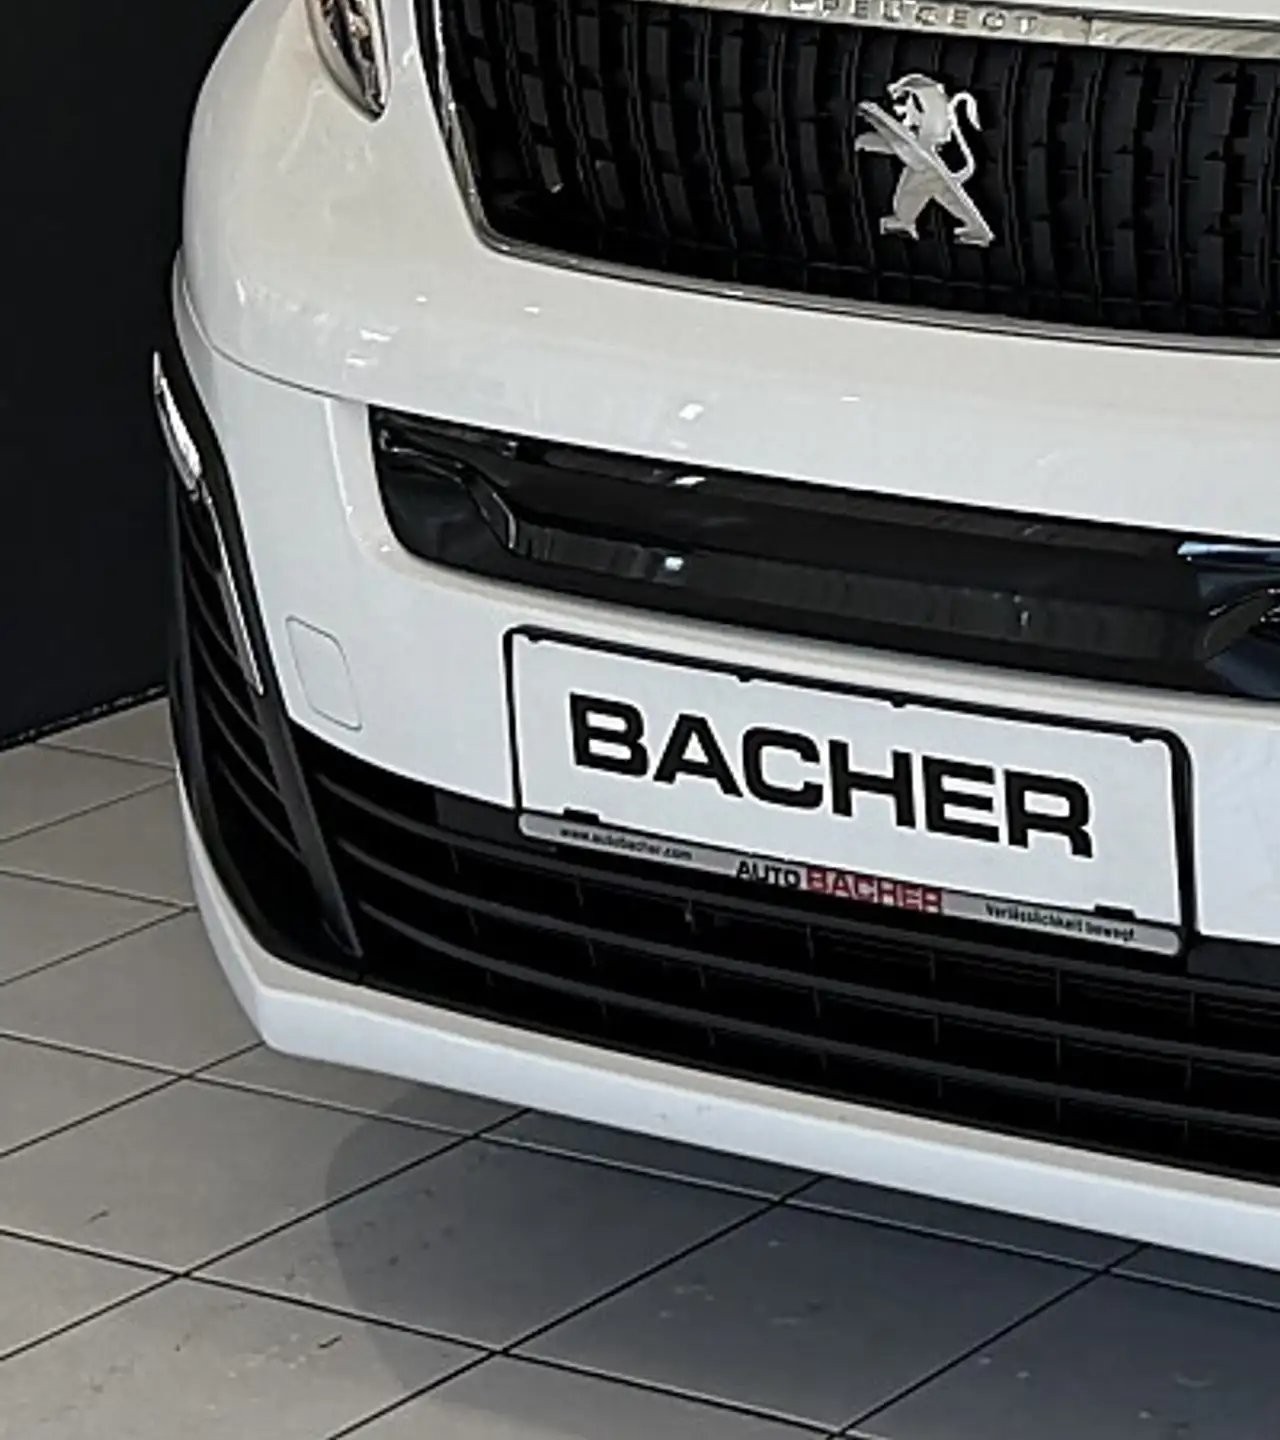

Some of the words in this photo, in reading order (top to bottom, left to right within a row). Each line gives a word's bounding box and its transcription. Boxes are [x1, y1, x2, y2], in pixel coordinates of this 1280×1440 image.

[568, 691, 1094, 859] BACHER
[560, 827, 693, 861] www.autobacher.com
[735, 859, 800, 888] AUTO
[806, 866, 943, 912] BACHER
